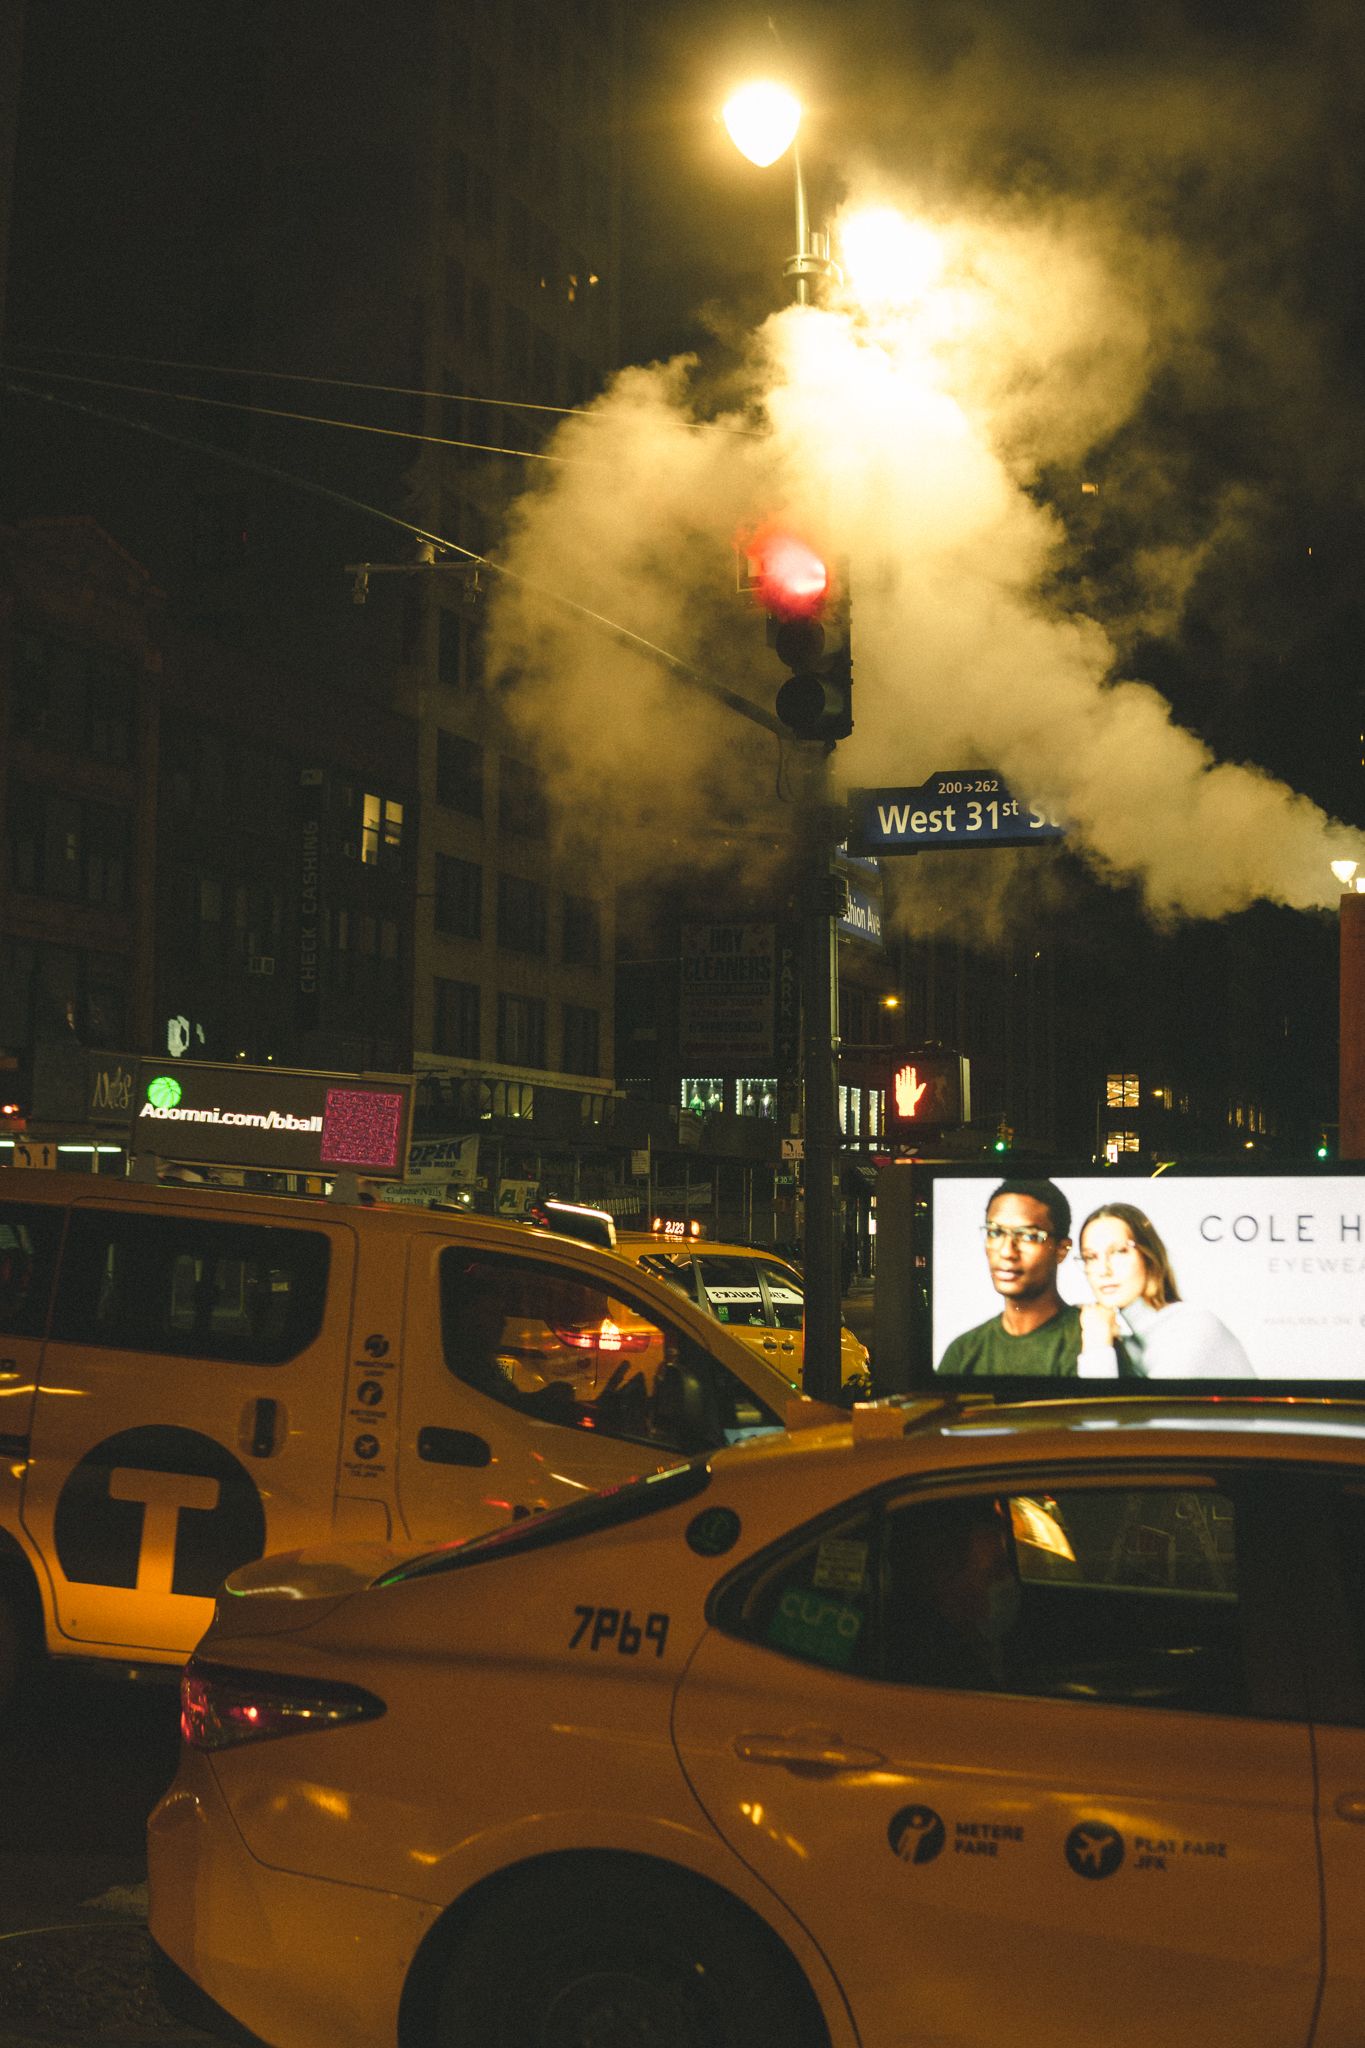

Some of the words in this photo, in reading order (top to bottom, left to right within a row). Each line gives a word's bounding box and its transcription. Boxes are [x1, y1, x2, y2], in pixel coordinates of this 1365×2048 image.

[938, 782, 963, 794] 200
[975, 780, 999, 793] 262
[877, 804, 957, 835] West
[966, 799, 1019, 831] 31st
[302, 819, 319, 915] CASHING
[867, 905, 881, 937] Ave
[301, 926, 317, 993] CHECK
[139, 1103, 323, 1132] Adomni.com/bball
[409, 1142, 462, 1162] OPEN
[665, 1221, 685, 1235] 2J23
[1199, 1214, 1315, 1243] COLE
[780, 1594, 861, 1638] curb
[954, 1838, 998, 1858] FARE
